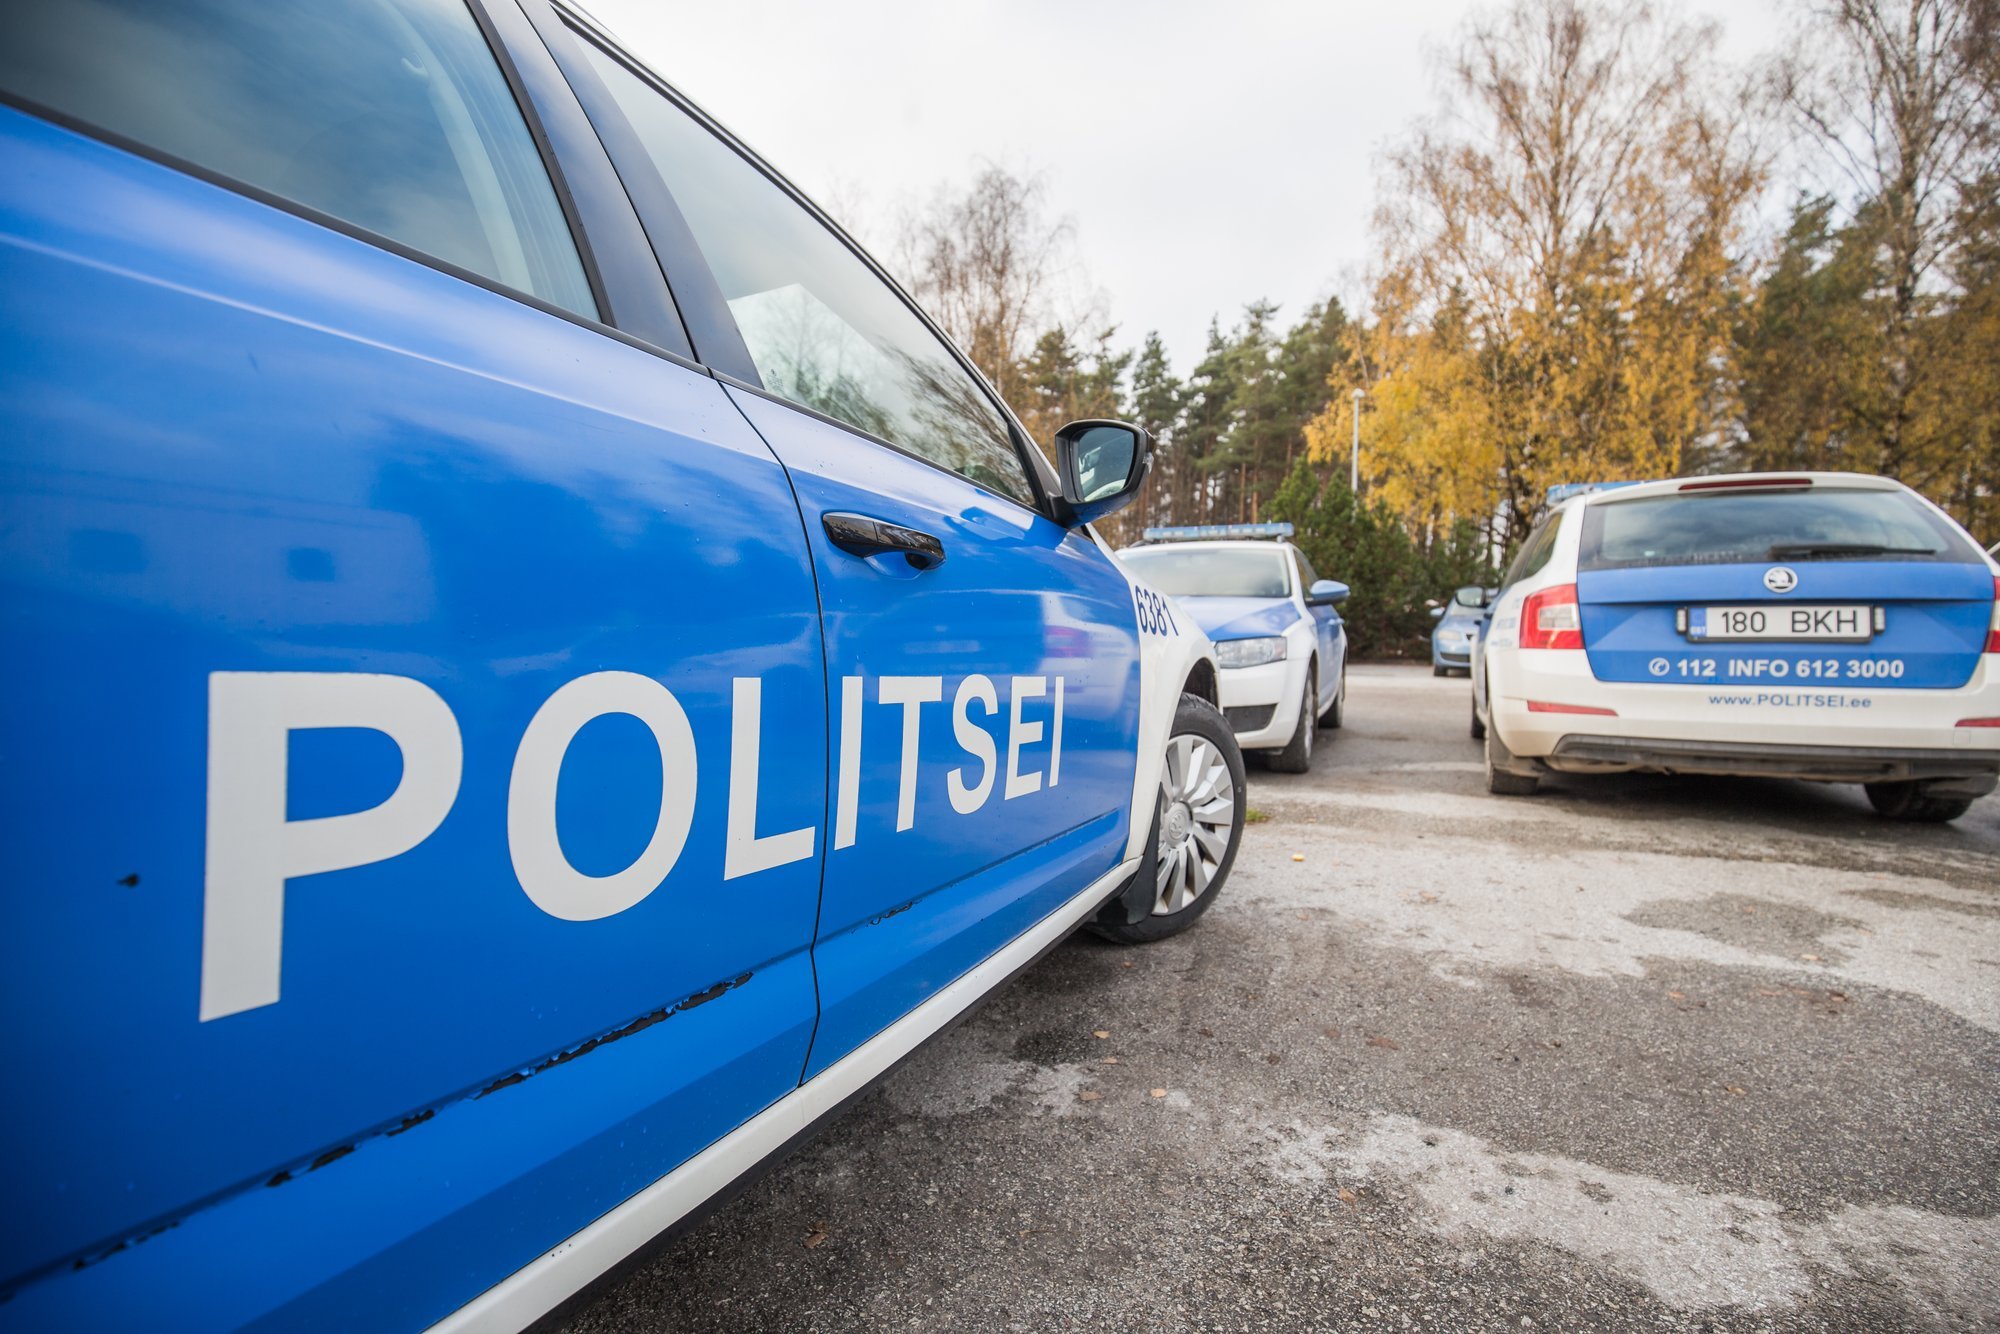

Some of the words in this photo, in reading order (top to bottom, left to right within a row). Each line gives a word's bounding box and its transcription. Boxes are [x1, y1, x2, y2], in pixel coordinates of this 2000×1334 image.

[1135, 585, 1179, 636] 6381
[1721, 611, 1766, 633] 180
[1791, 610, 1857, 633] BKH
[1677, 659, 1716, 677] 112
[1728, 659, 1789, 678] INFO
[1796, 659, 1839, 678] 612
[1846, 660, 1904, 678] 3000
[1708, 694, 1872, 708] www.POLITSEI.ee
[200, 670, 1065, 1022] POLITSEI
